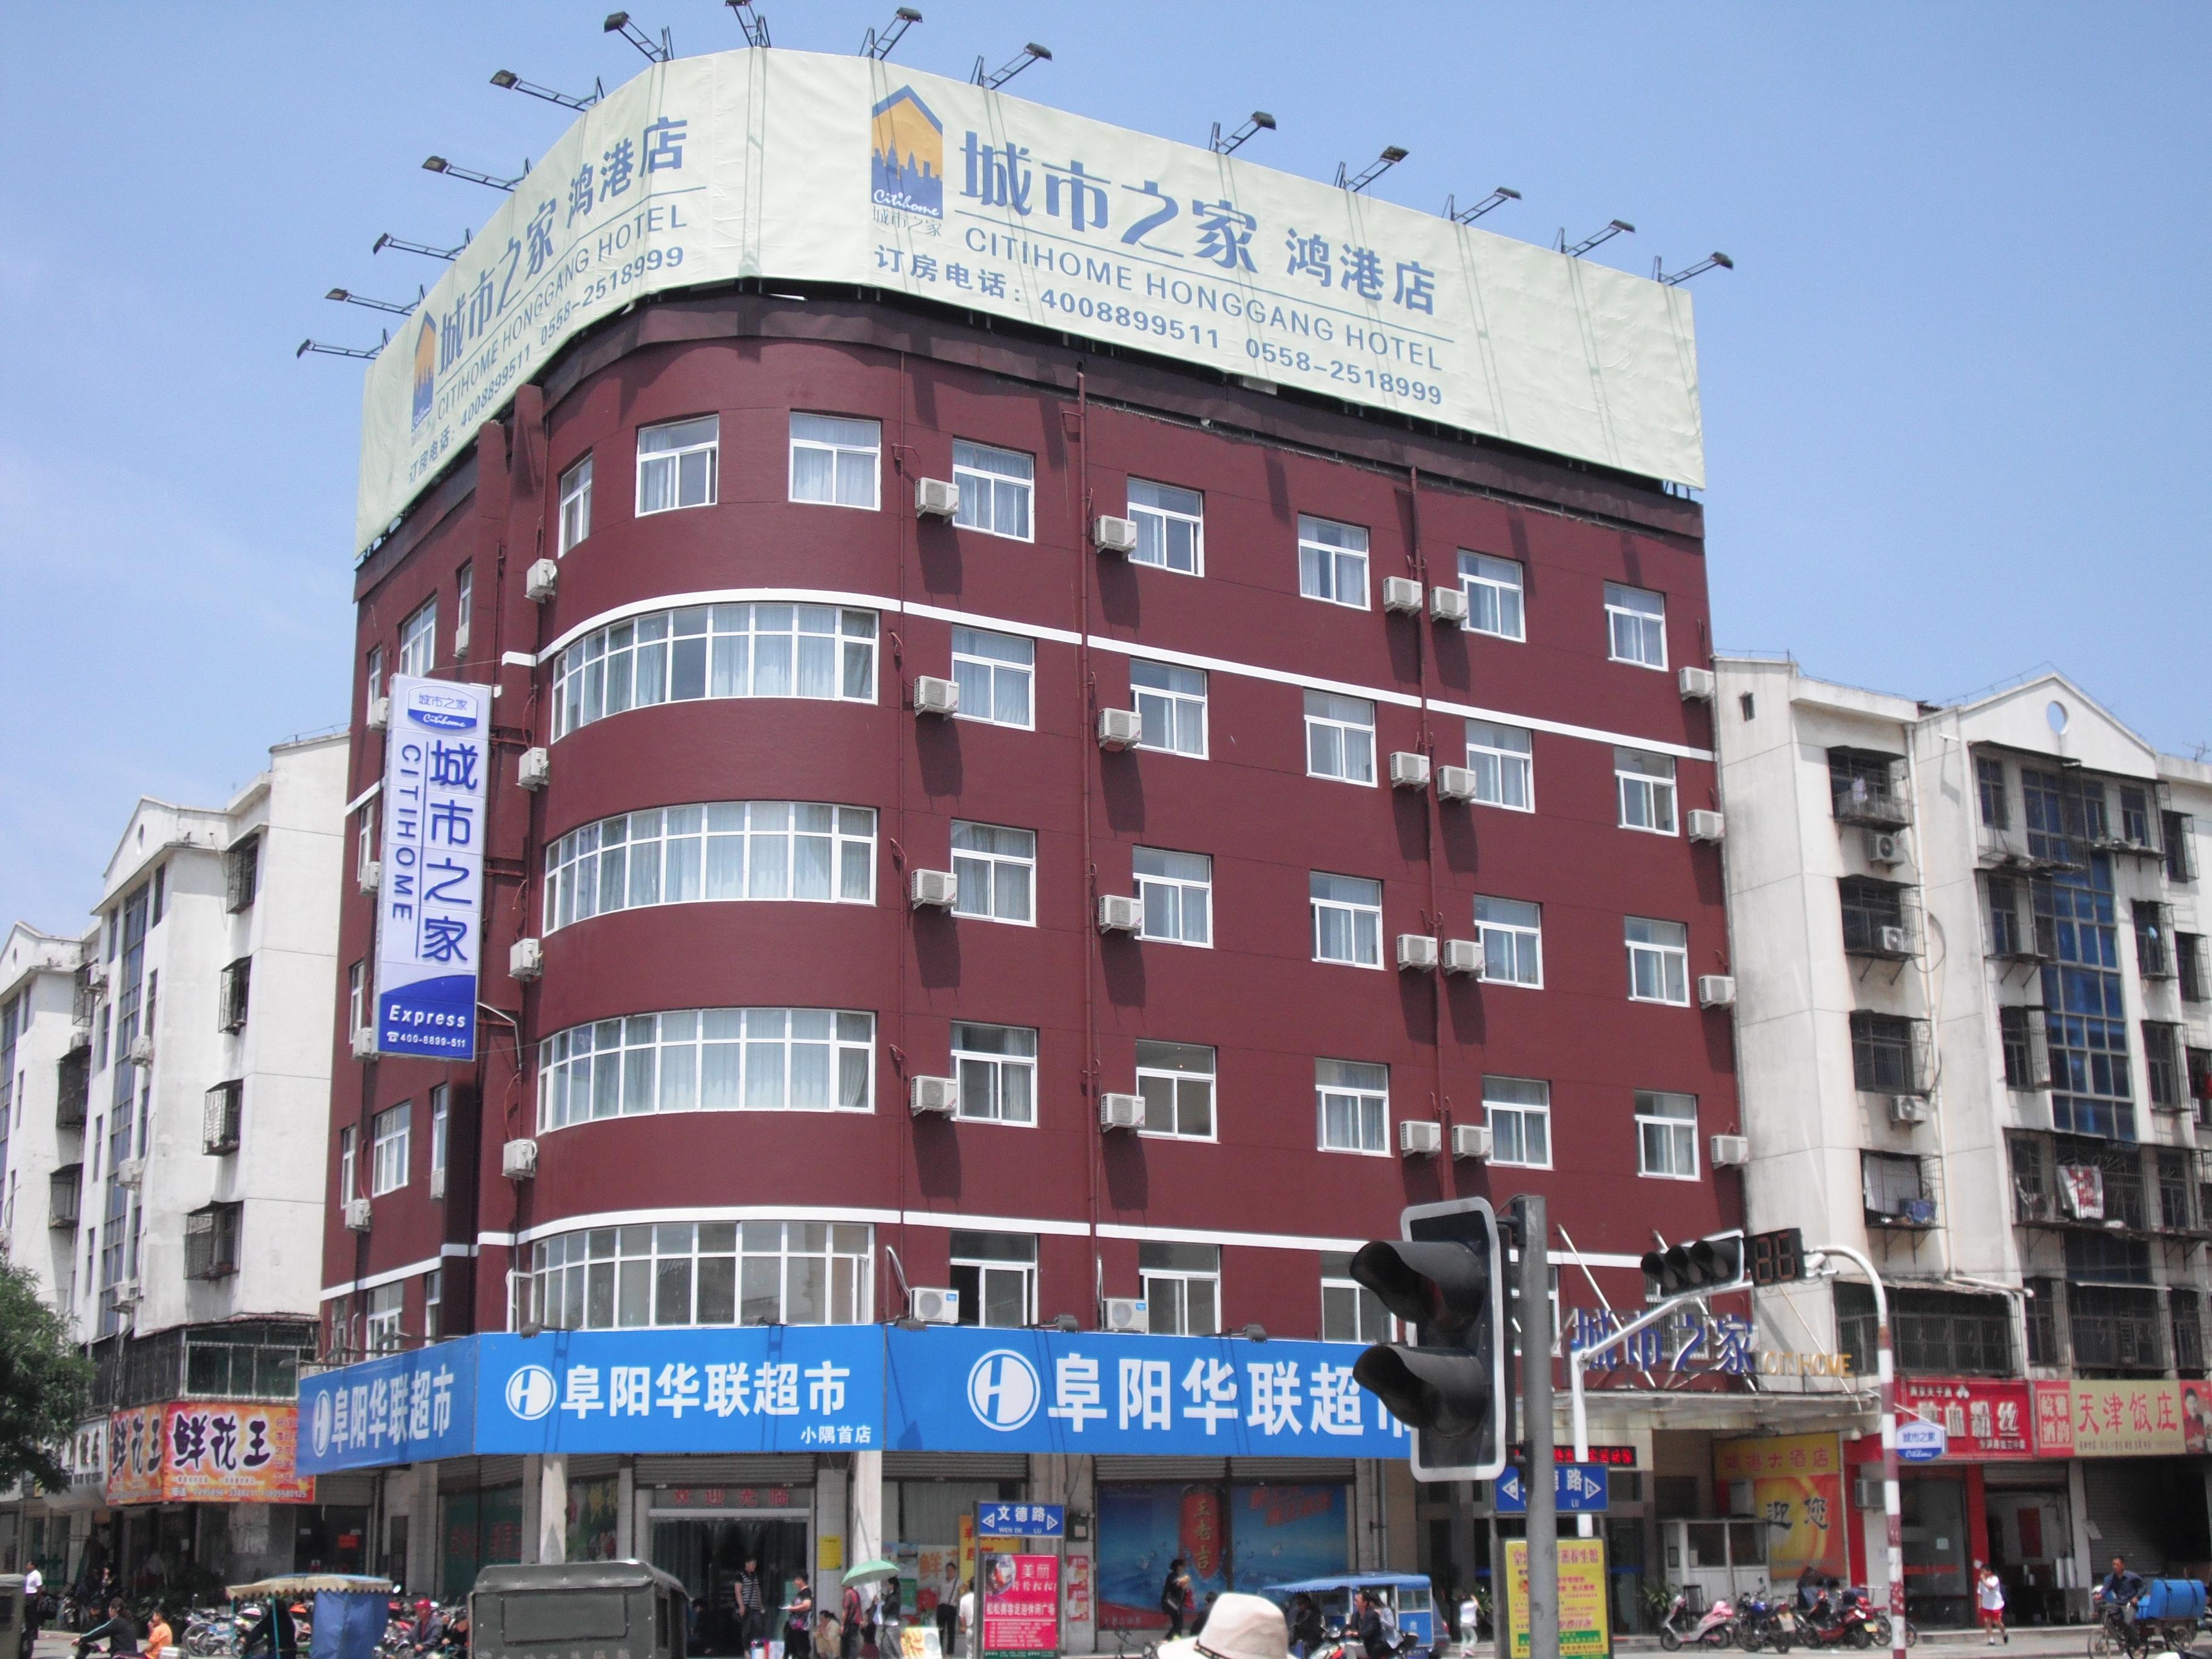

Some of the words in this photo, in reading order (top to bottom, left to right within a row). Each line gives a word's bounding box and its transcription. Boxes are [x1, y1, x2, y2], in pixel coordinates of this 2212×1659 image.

[872, 205, 941, 236] 城市之家
[874, 189, 939, 215] Citihome
[958, 131, 1258, 273] 城市之家
[1285, 227, 1435, 315] 鸿港店
[438, 196, 557, 377] 城市之家
[566, 117, 687, 229] 鸿港店
[438, 344, 498, 419] CITIHOME
[503, 249, 589, 352] HONGGANG
[598, 204, 686, 261] HOTEL
[965, 226, 1133, 291] CITIHOME
[1146, 270, 1334, 340] HONGGANG
[1346, 326, 1443, 372] HOTEL
[460, 344, 531, 427] 4008899511
[541, 247, 683, 346] 0558-2518999
[1041, 288, 1219, 349] 4008899511
[1245, 338, 1443, 406] 0558-2518999
[418, 692, 467, 711] 城市之家
[391, 743, 421, 920] CITIHOME
[422, 739, 478, 962] 城市之家
[389, 1005, 466, 1028] Express
[560, 1360, 850, 1419] 阜阳华联超市
[1763, 1352, 1854, 1378] CITIHOME
[331, 1364, 454, 1453] 阜阳华联超市
[800, 1426, 871, 1445] 小隅首店
[2078, 1390, 2178, 1435] 天津饭庄
[112, 1416, 161, 1478] 鲜花王
[173, 1413, 270, 1470] 鲜花王
[674, 1488, 789, 1507] 欢迎光临
[998, 1506, 1045, 1523] 文德路
[1195, 1501, 1212, 1570] 王老吉
[1022, 1563, 1050, 1580] 美丽
